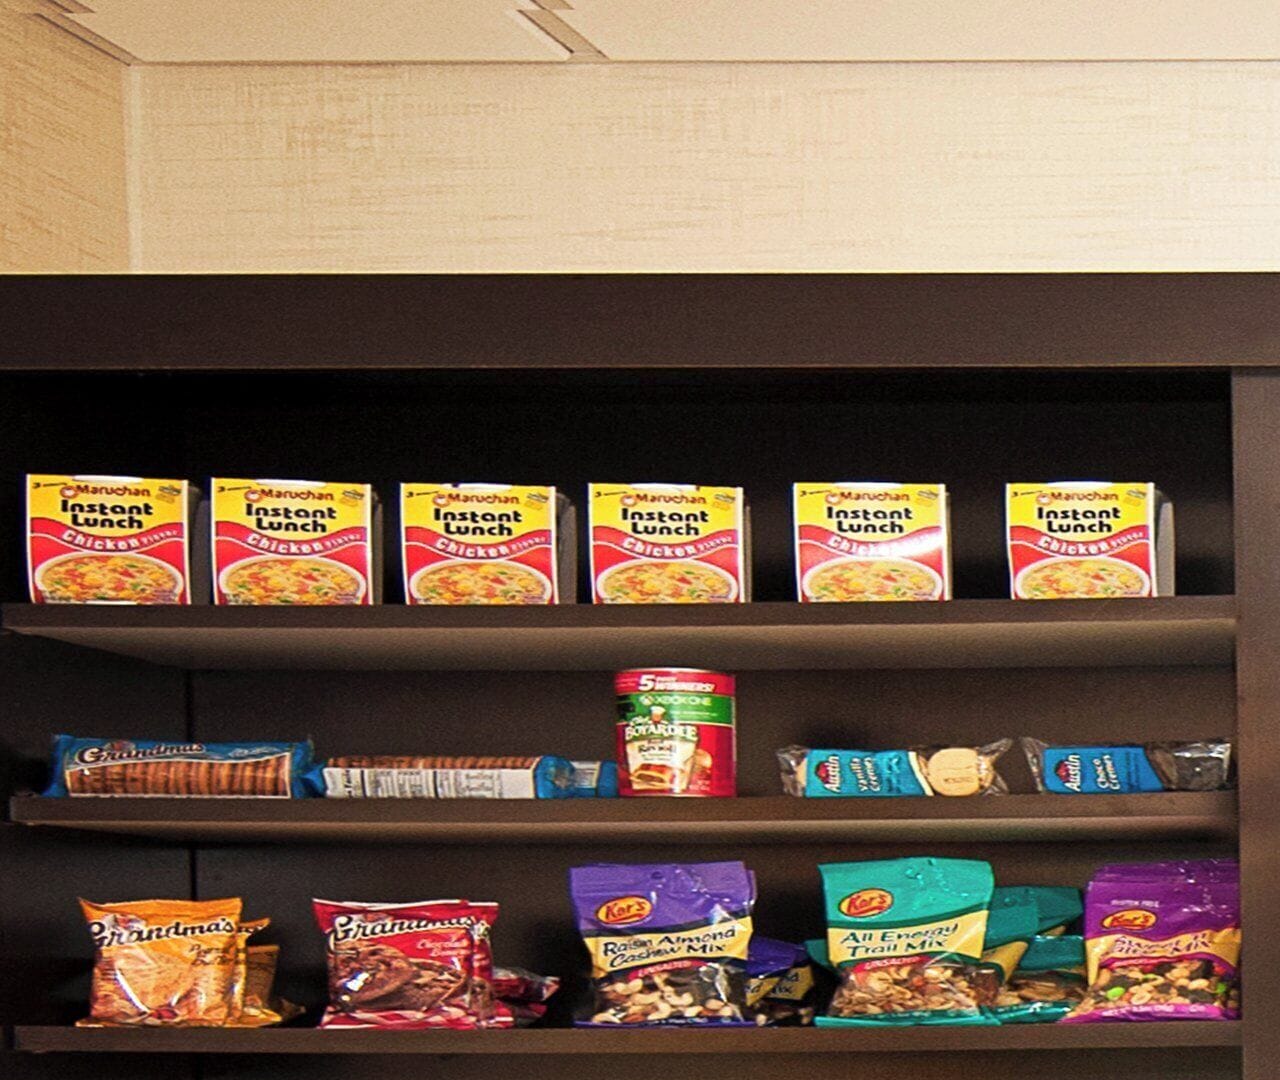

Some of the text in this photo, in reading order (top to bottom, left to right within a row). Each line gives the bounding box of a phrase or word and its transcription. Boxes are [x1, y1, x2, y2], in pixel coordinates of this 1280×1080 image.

[76, 484, 151, 499] Maruchan
[261, 488, 334, 502] Maruchan
[447, 492, 520, 506] Maruchan
[636, 492, 707, 506] Maruchan
[840, 491, 910, 503] Maruchan
[1050, 491, 1119, 503] Maruchan
[61, 500, 153, 516] Instant
[246, 504, 337, 520] Instant
[434, 508, 522, 523] Instant
[621, 508, 709, 523] Instant
[827, 506, 914, 521] Instant
[1037, 506, 1121, 521] Instant
[72, 514, 144, 530] Lunch
[256, 517, 327, 533] Lunch
[444, 522, 513, 537] Lunch
[631, 522, 699, 537] Lunch
[837, 520, 905, 534] Lunch
[1047, 520, 1113, 534] Lunch
[62, 529, 139, 551] Chicken
[247, 533, 323, 555] Chicken
[436, 536, 510, 558] Chicken
[623, 536, 698, 558] Chicken
[1038, 535, 1111, 556] Chicken
[638, 674, 656, 691] 5
[625, 723, 698, 742] BOYARDEE
[824, 755, 841, 793] Austin
[850, 757, 868, 792] Vanilla
[1064, 754, 1080, 792] Austin
[1093, 758, 1108, 789] Choco
[847, 891, 889, 914] Kar's
[89, 915, 235, 950] Grandma's
[840, 922, 959, 944] All Energy
[602, 926, 737, 956] Raisin Almond
[847, 938, 949, 958] Trail Mix
[609, 940, 727, 969] Cashew Mix
